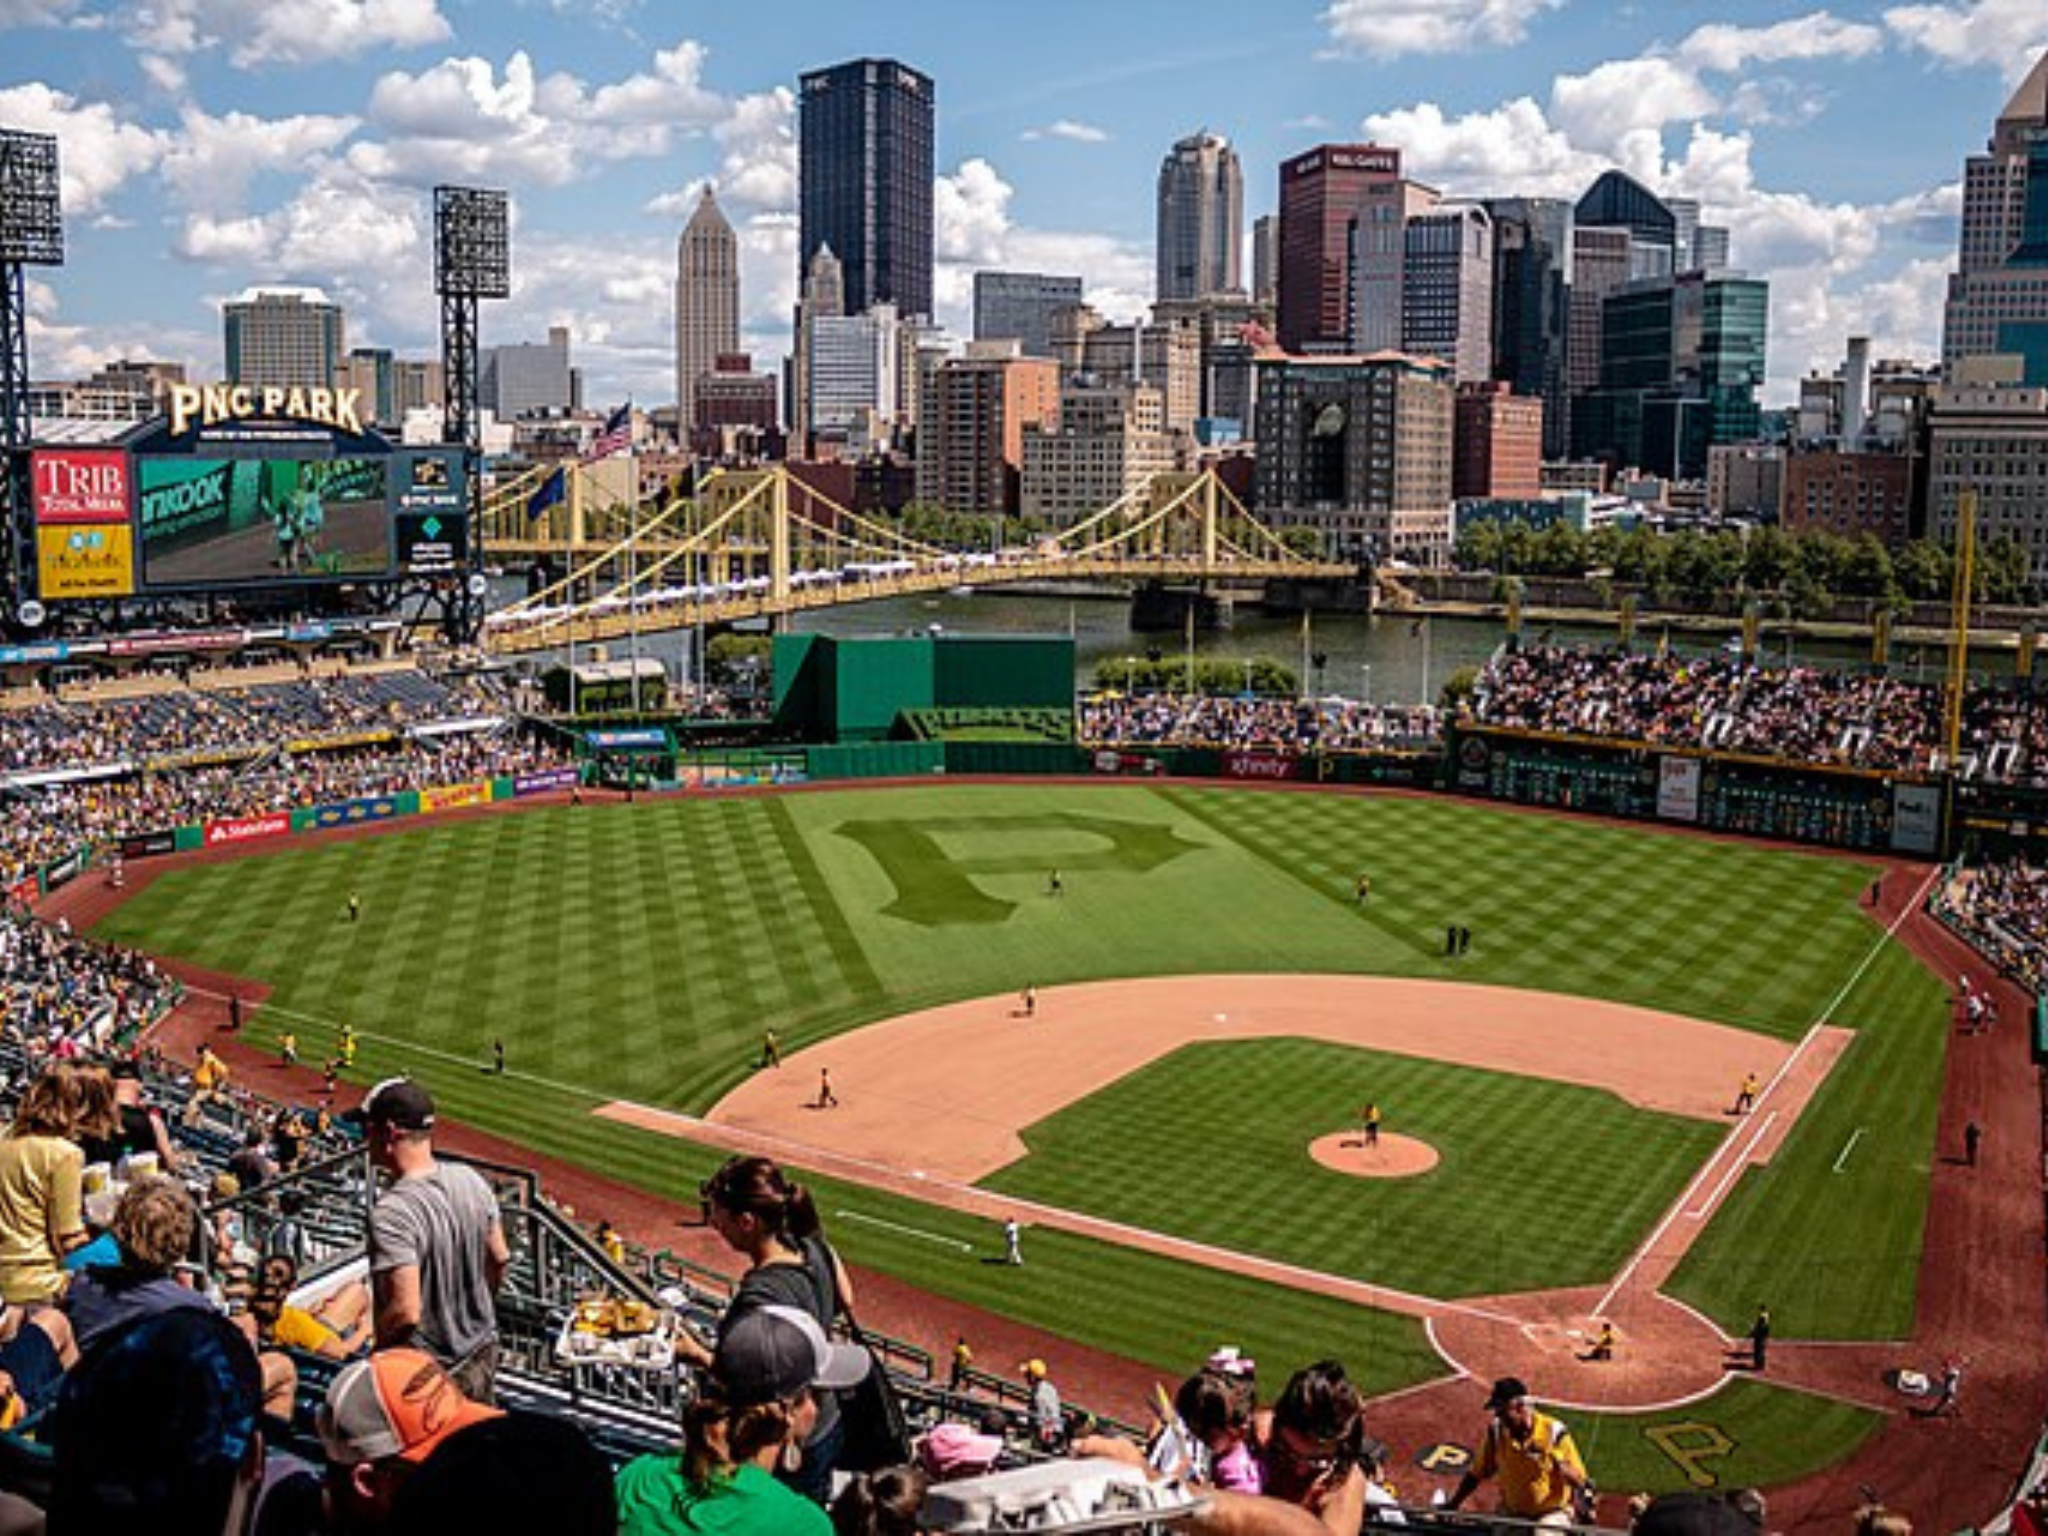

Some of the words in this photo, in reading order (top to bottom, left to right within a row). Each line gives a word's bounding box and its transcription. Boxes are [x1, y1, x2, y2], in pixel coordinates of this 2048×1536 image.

[169, 381, 254, 437] PNC
[263, 383, 363, 437] PARK
[37, 460, 122, 495] TRIB
